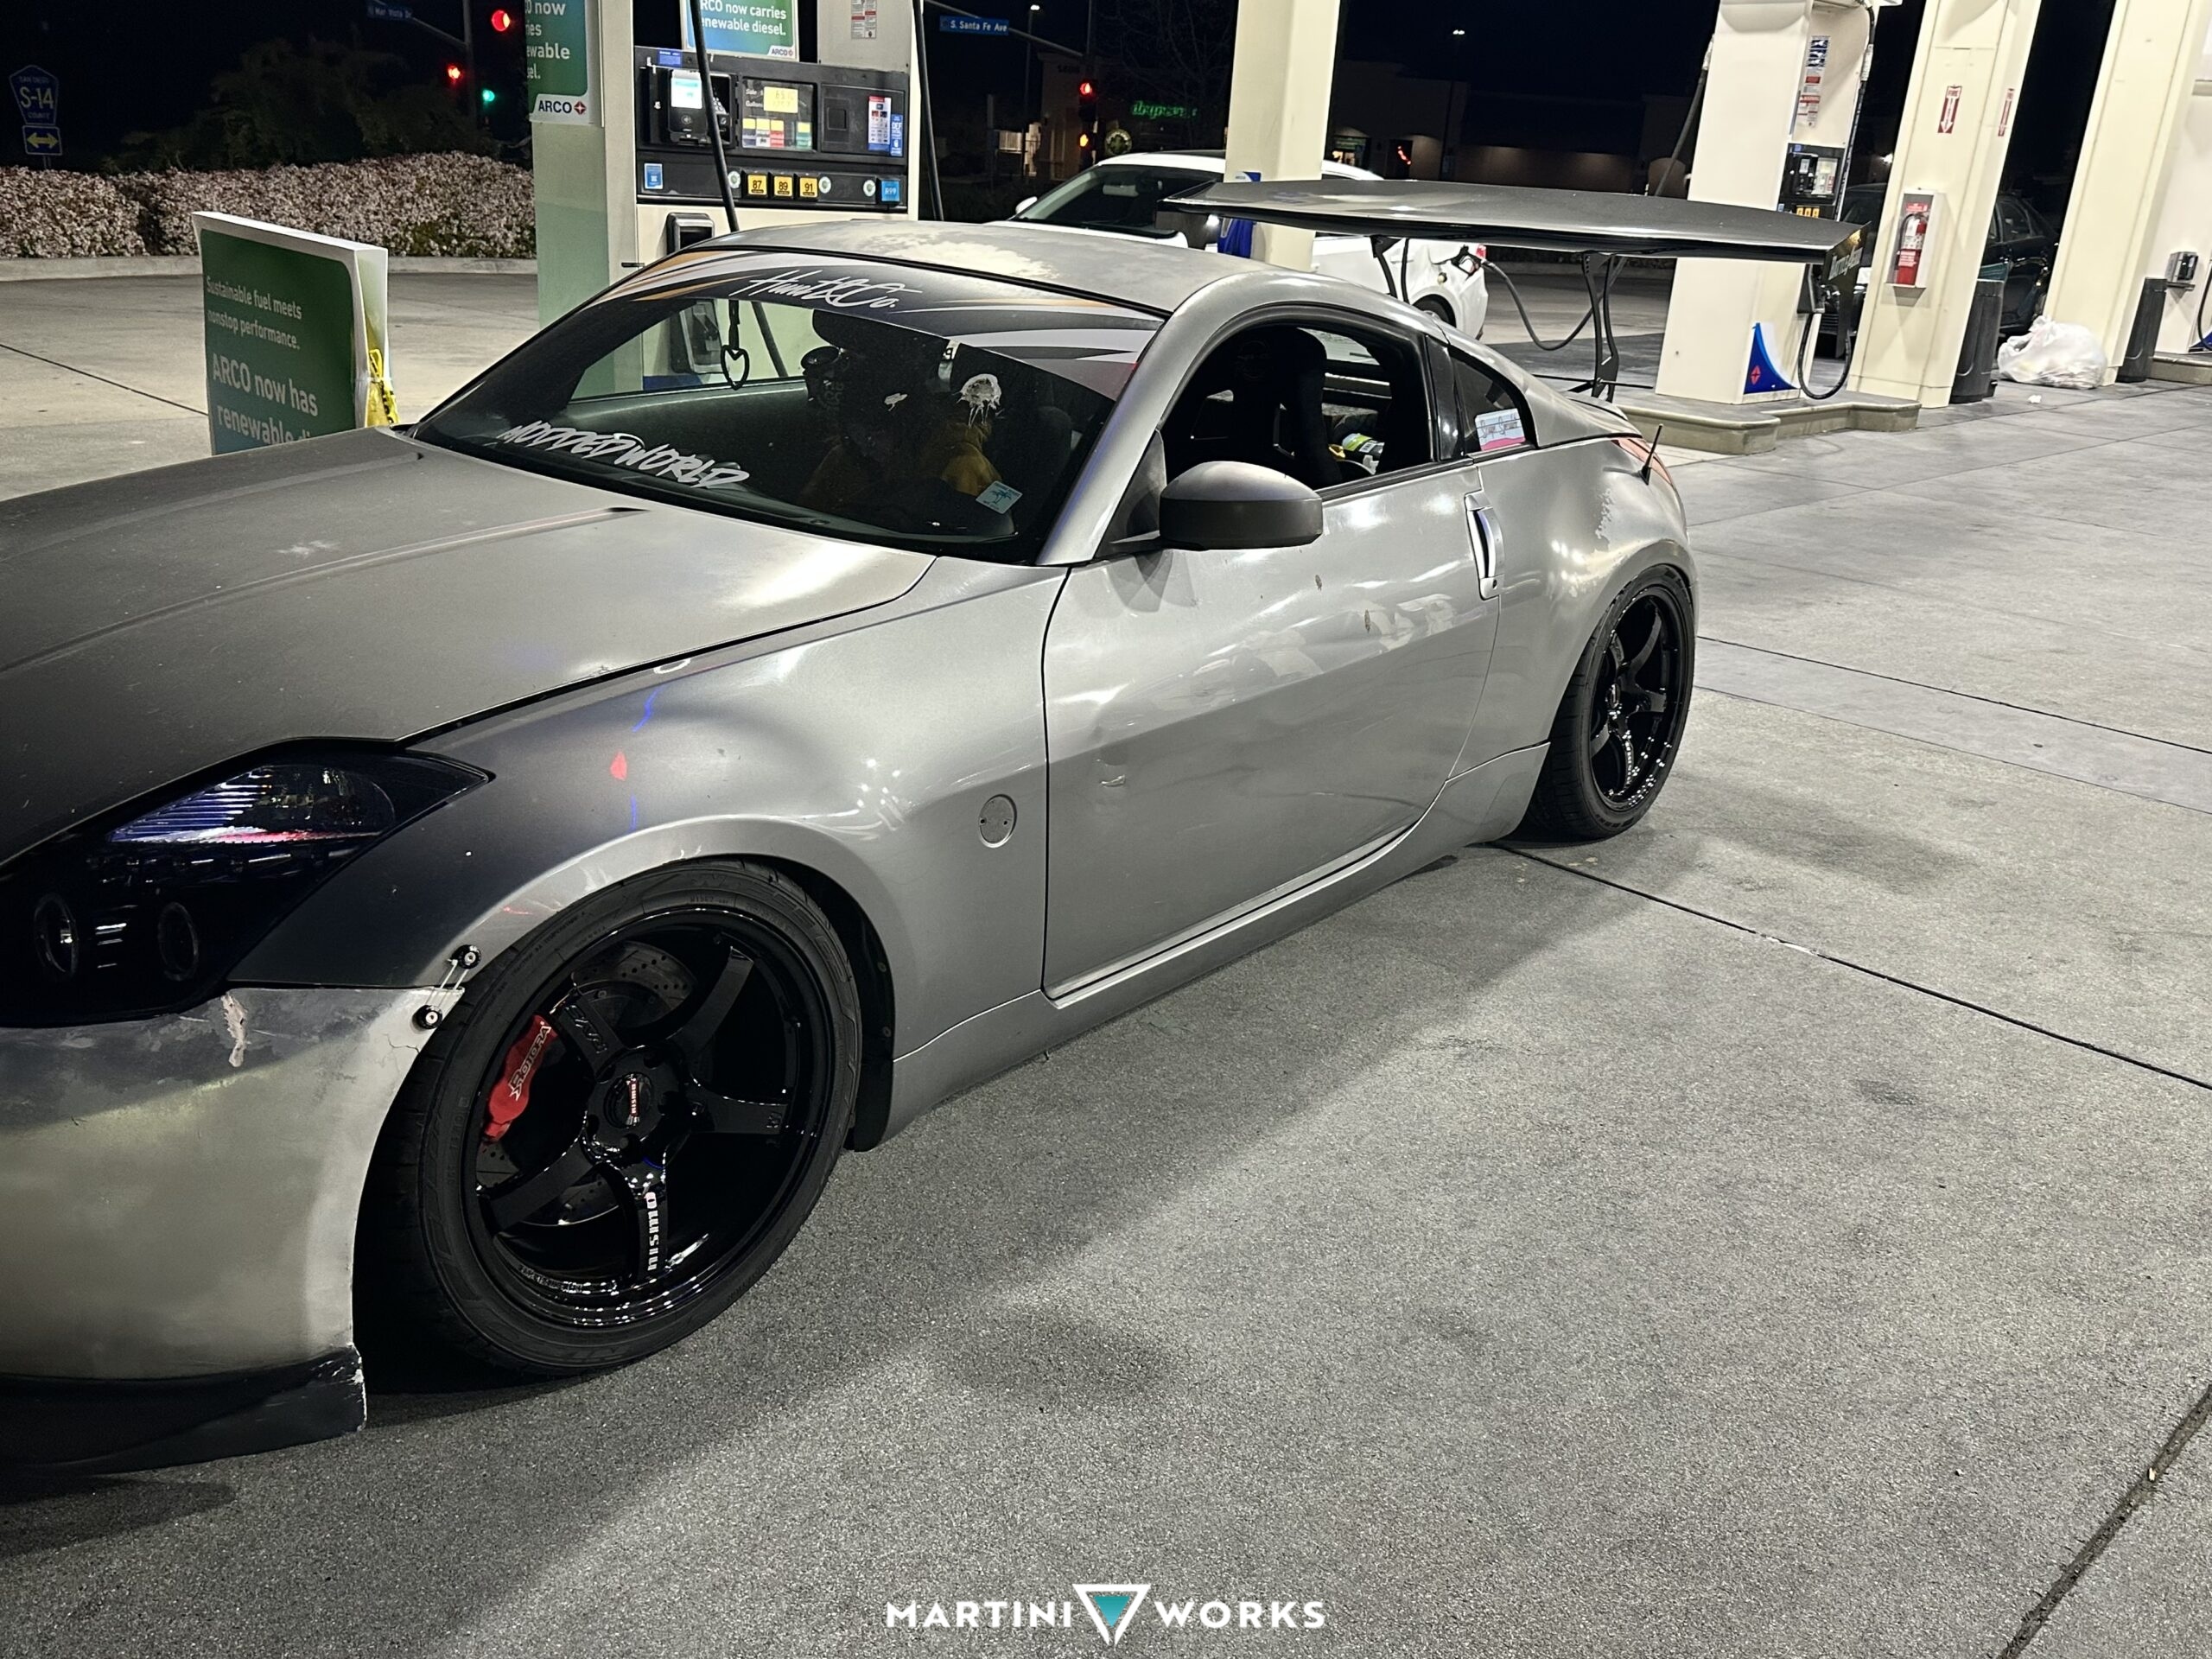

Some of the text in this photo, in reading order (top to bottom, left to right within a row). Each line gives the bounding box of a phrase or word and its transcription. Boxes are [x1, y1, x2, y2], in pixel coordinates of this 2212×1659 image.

[535, 3, 566, 16] now
[700, 0, 786, 20] RCO now carries
[752, 21, 786, 35] diesel.
[959, 21, 981, 30] Santa
[982, 22, 991, 31] Fe
[994, 22, 1007, 32] Ave
[20, 86, 54, 109] S-14
[538, 100, 572, 113] ARCO
[753, 180, 763, 189] 87
[779, 181, 788, 191] 89
[804, 182, 814, 192] 91
[207, 276, 302, 321] Sustainable fuel meets
[207, 309, 301, 350] nonstop performance.
[213, 353, 318, 417] ARCO now has
[645, 1192, 659, 1271] nismo
